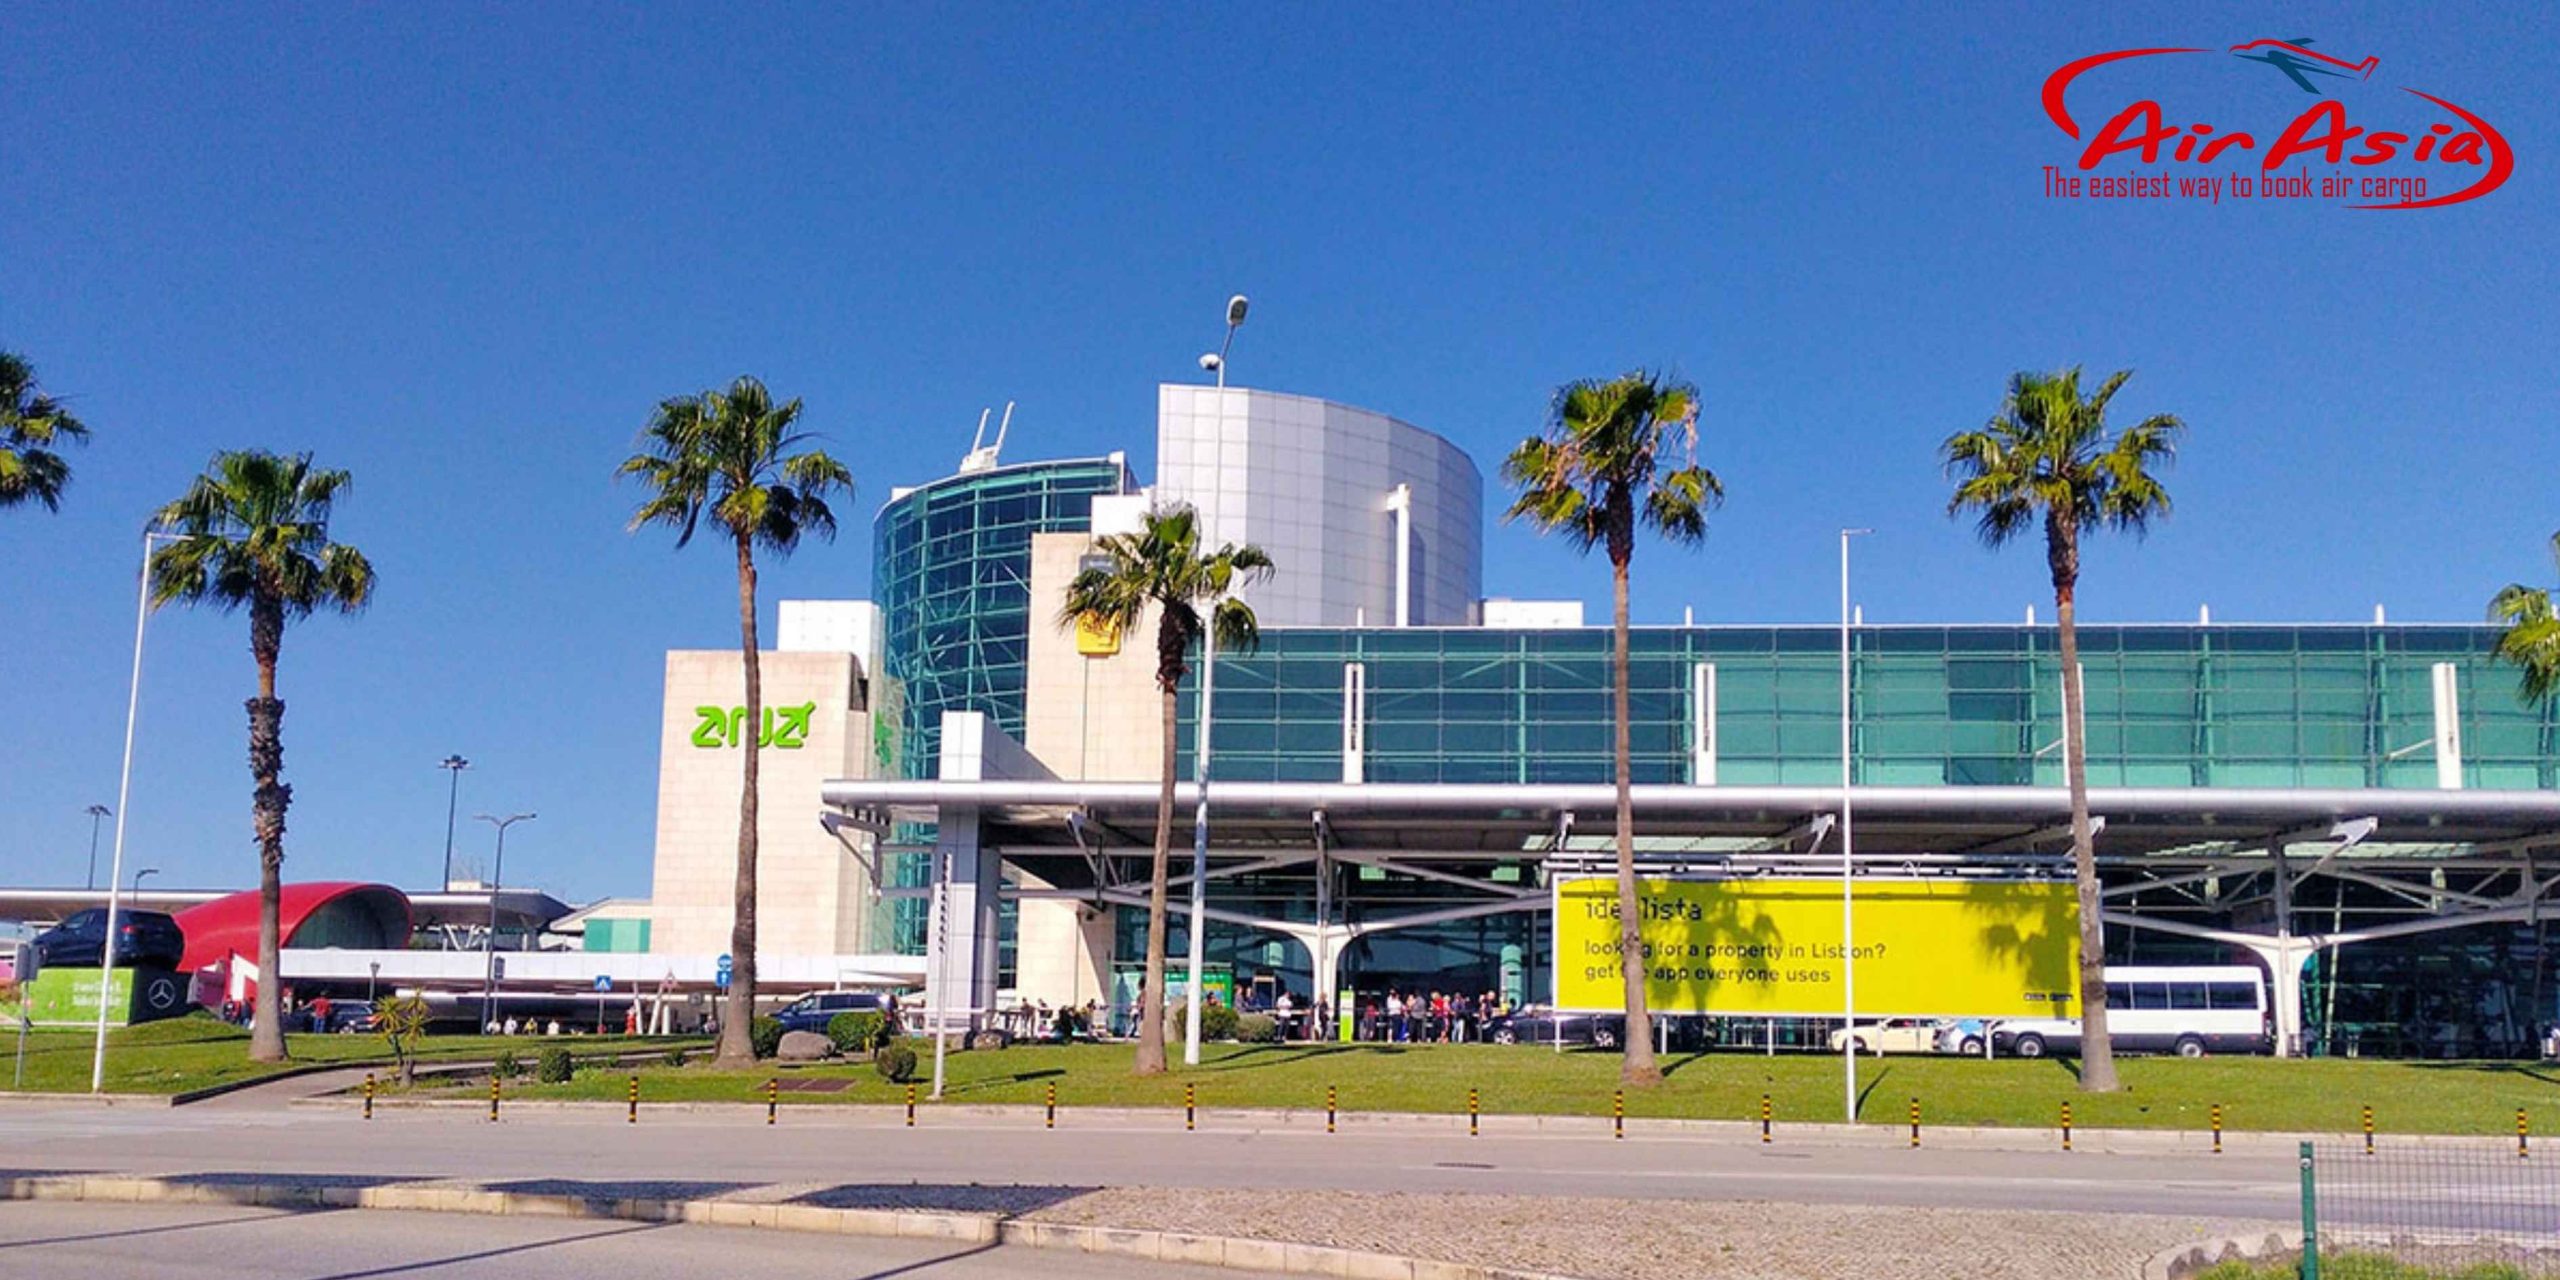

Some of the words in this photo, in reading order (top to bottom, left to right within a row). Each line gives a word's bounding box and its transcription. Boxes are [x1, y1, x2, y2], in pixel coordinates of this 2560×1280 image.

[1585, 896, 1702, 921] idelista
[1585, 940, 1653, 959] lookg
[1657, 940, 1683, 956] for
[1689, 945, 1699, 956] a
[1705, 942, 1783, 960] property
[1789, 943, 1805, 958] in
[1585, 964, 1614, 981] get
[1654, 967, 1689, 982] app
[1695, 967, 1779, 983] everyone
[1786, 970, 1831, 982] uses
